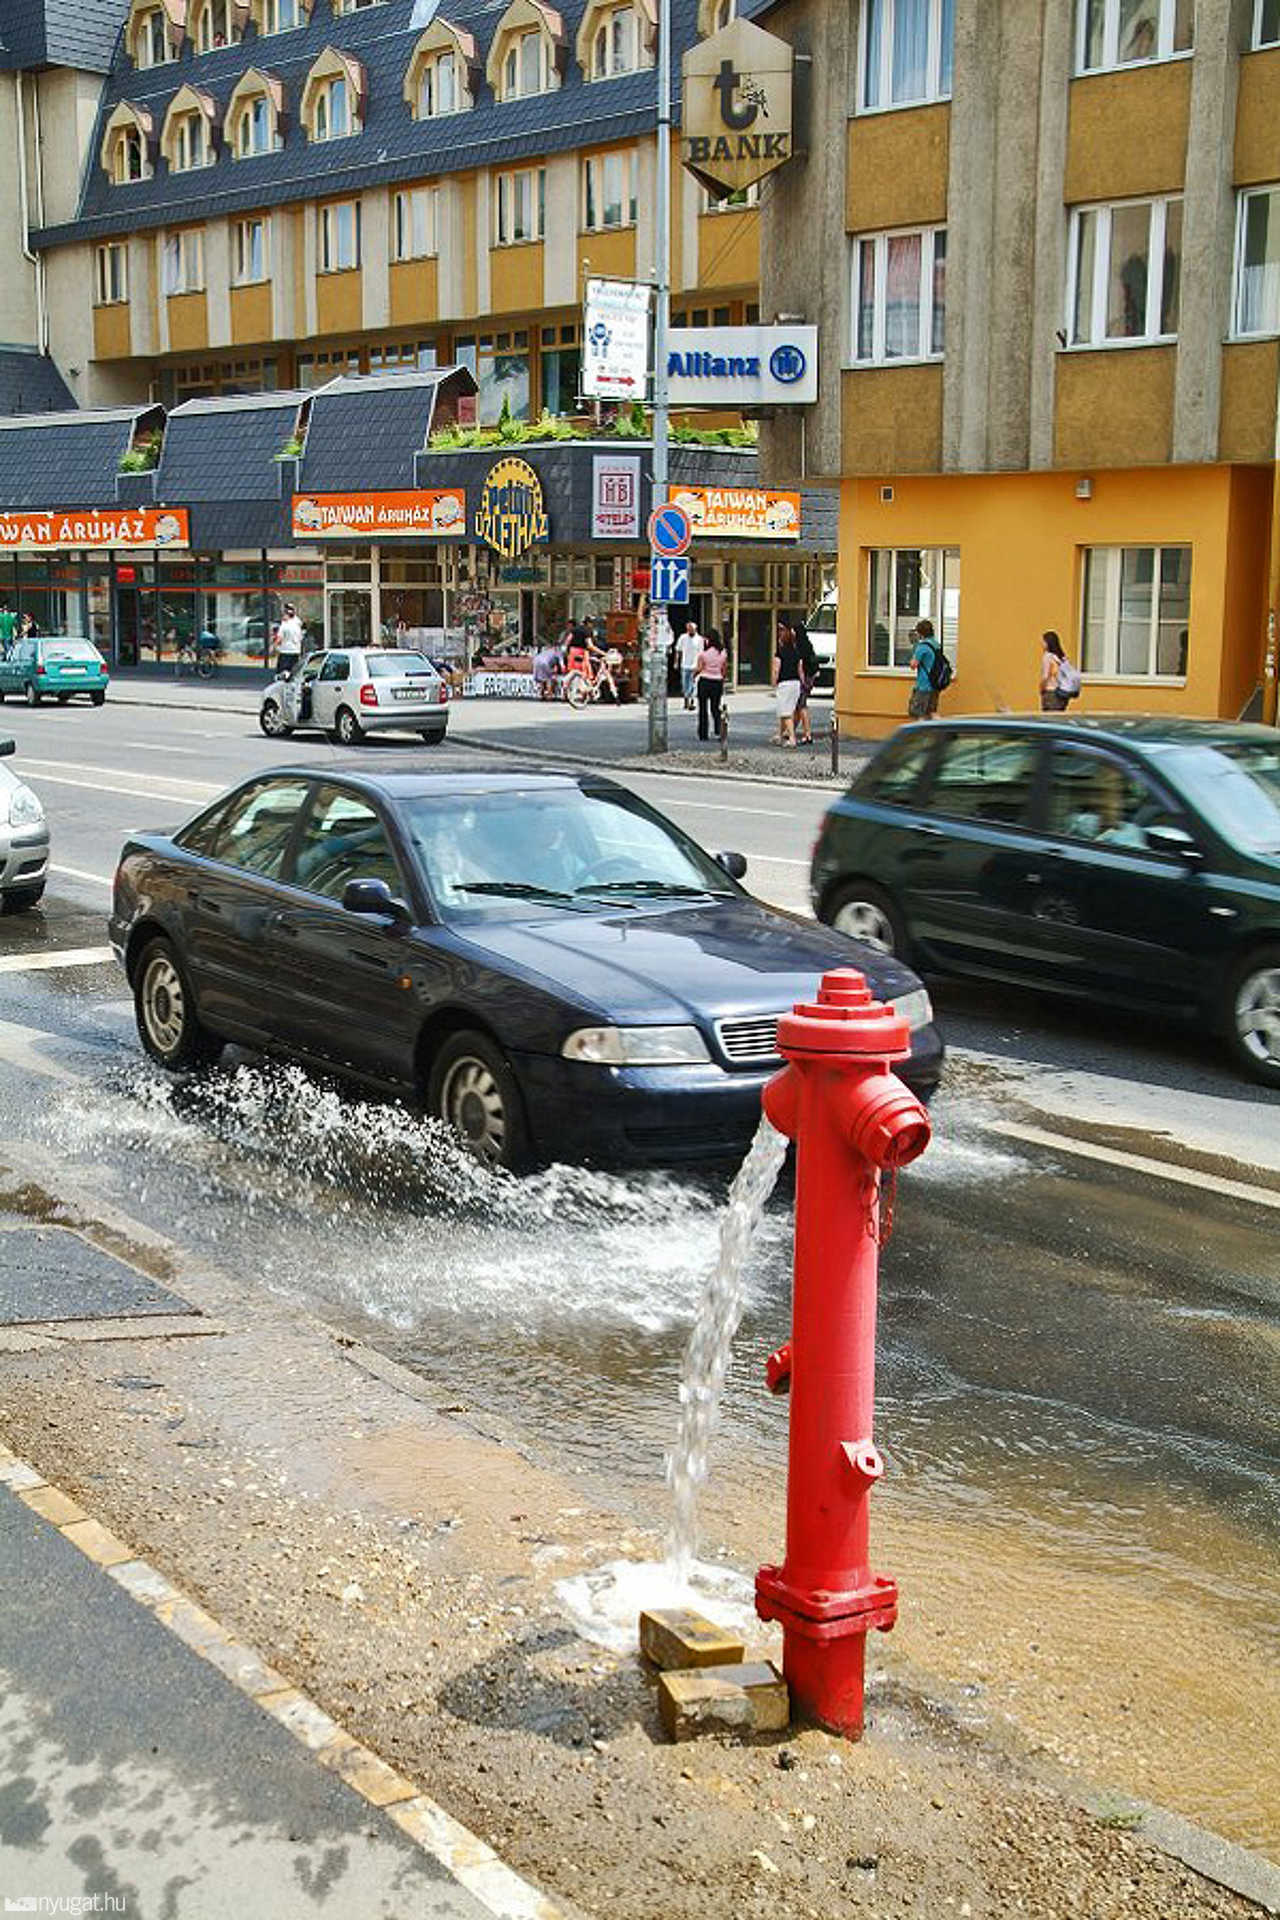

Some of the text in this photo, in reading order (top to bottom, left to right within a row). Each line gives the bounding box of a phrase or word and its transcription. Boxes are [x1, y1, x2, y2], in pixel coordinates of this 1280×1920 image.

[689, 133, 789, 161] BANK
[667, 351, 760, 378] Allianz
[322, 504, 374, 524] TAIWAN
[706, 491, 767, 511] TAIWAN
[59, 515, 145, 543] ÁRUHÁZ
